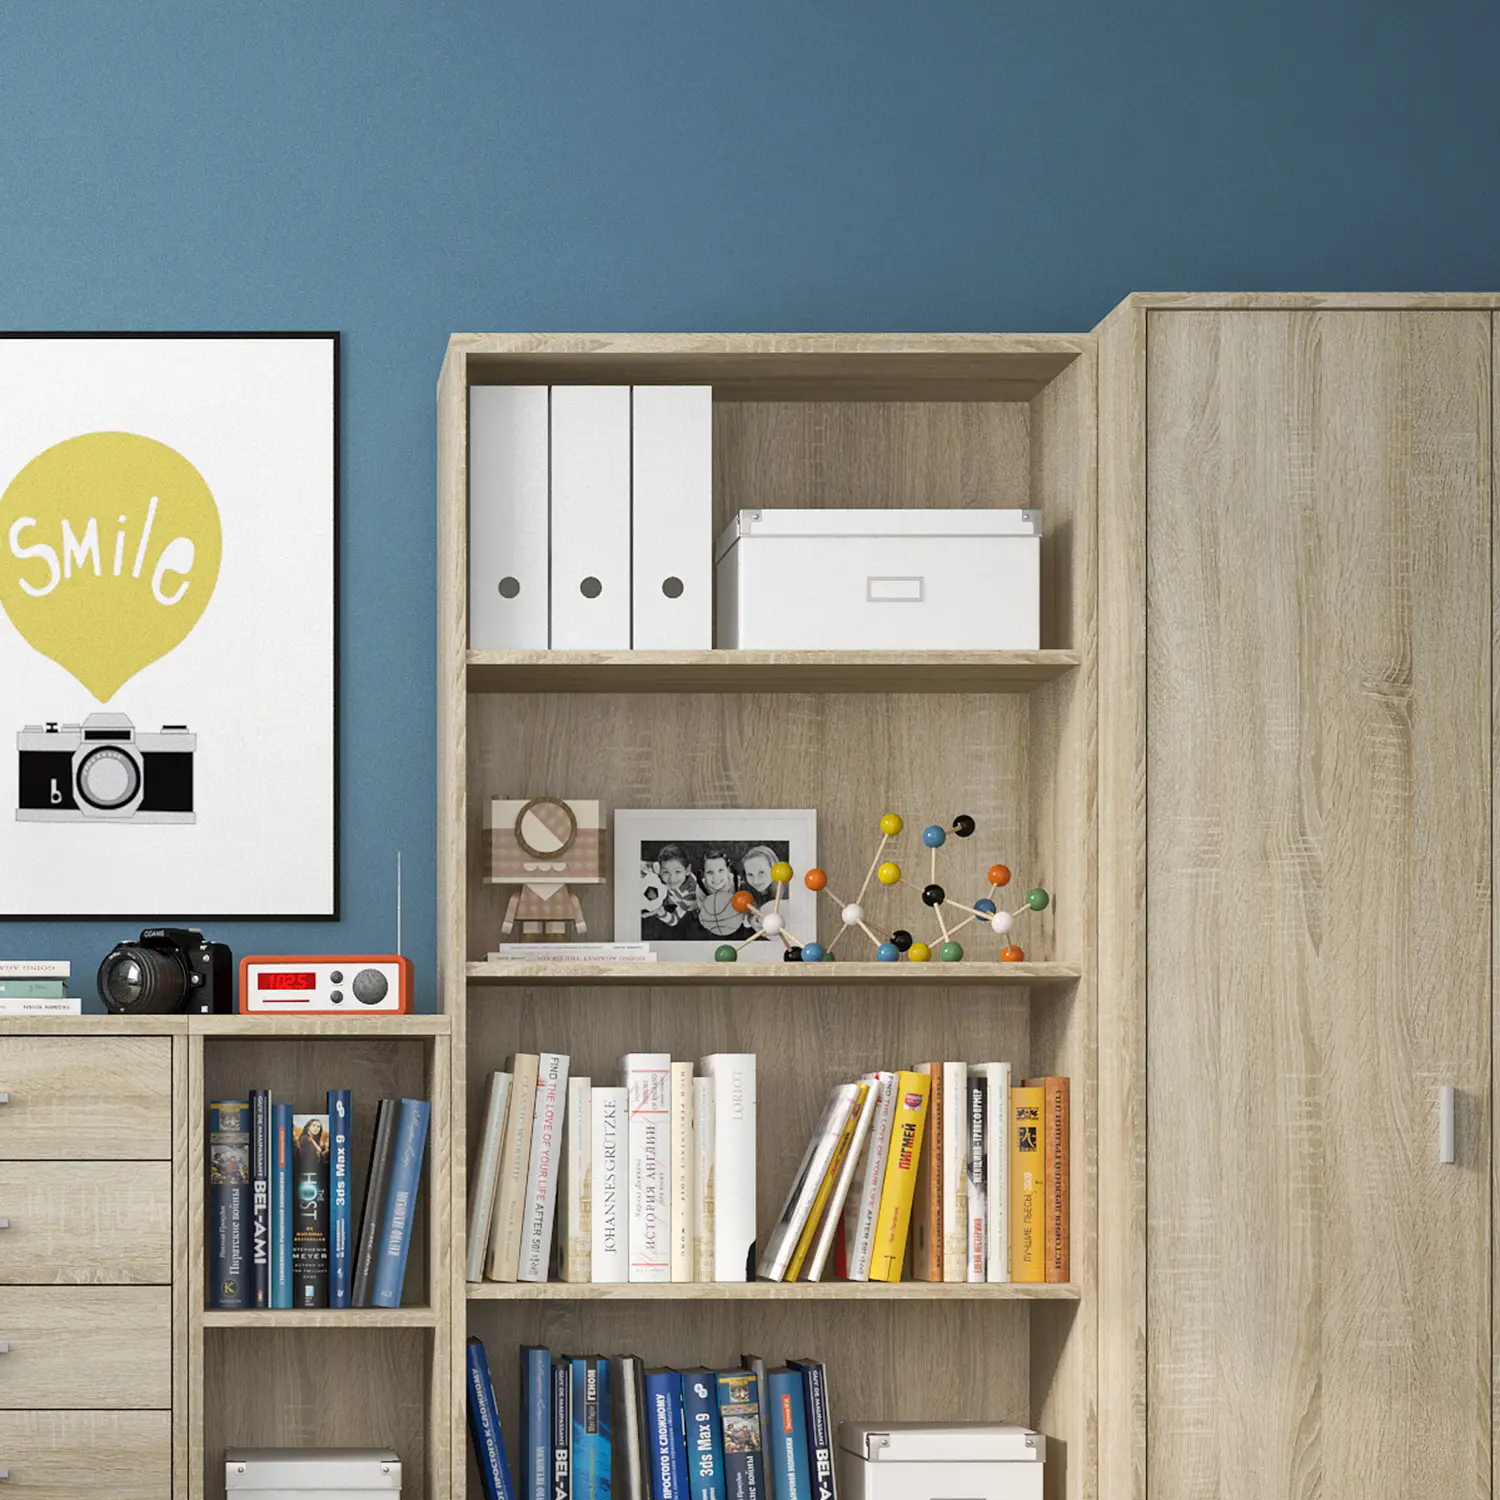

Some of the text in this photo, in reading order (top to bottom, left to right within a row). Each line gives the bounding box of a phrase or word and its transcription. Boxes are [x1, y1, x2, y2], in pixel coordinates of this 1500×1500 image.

[549, 1056, 560, 1081] FIND
[546, 1083, 557, 1102] THE
[732, 1071, 744, 1121] LORIOT
[542, 1133, 553, 1148] OF
[543, 1104, 555, 1131] LOVE
[336, 1134, 345, 1206] 3ds Max 9
[538, 1150, 551, 1178] YOUR
[898, 1122, 917, 1171] ПИГМЕЙ
[300, 1172, 317, 1221] HOST
[535, 1180, 547, 1202] LIFE
[603, 1099, 617, 1255] JOHANNES GRÜTZKE
[254, 1180, 267, 1265] BEL-AMI
[533, 1203, 545, 1237] AFTER
[643, 1185, 657, 1251] ИСТОРИЯ
[228, 1222, 242, 1275] Пиратские
[586, 1369, 597, 1401] ГЕНОМ
[656, 1393, 669, 1445] СЛОЖНОМУ
[695, 1412, 714, 1477] 3ds Max 9
[660, 1453, 671, 1498] ПРОСТОГО
[746, 1455, 755, 1486] войны
